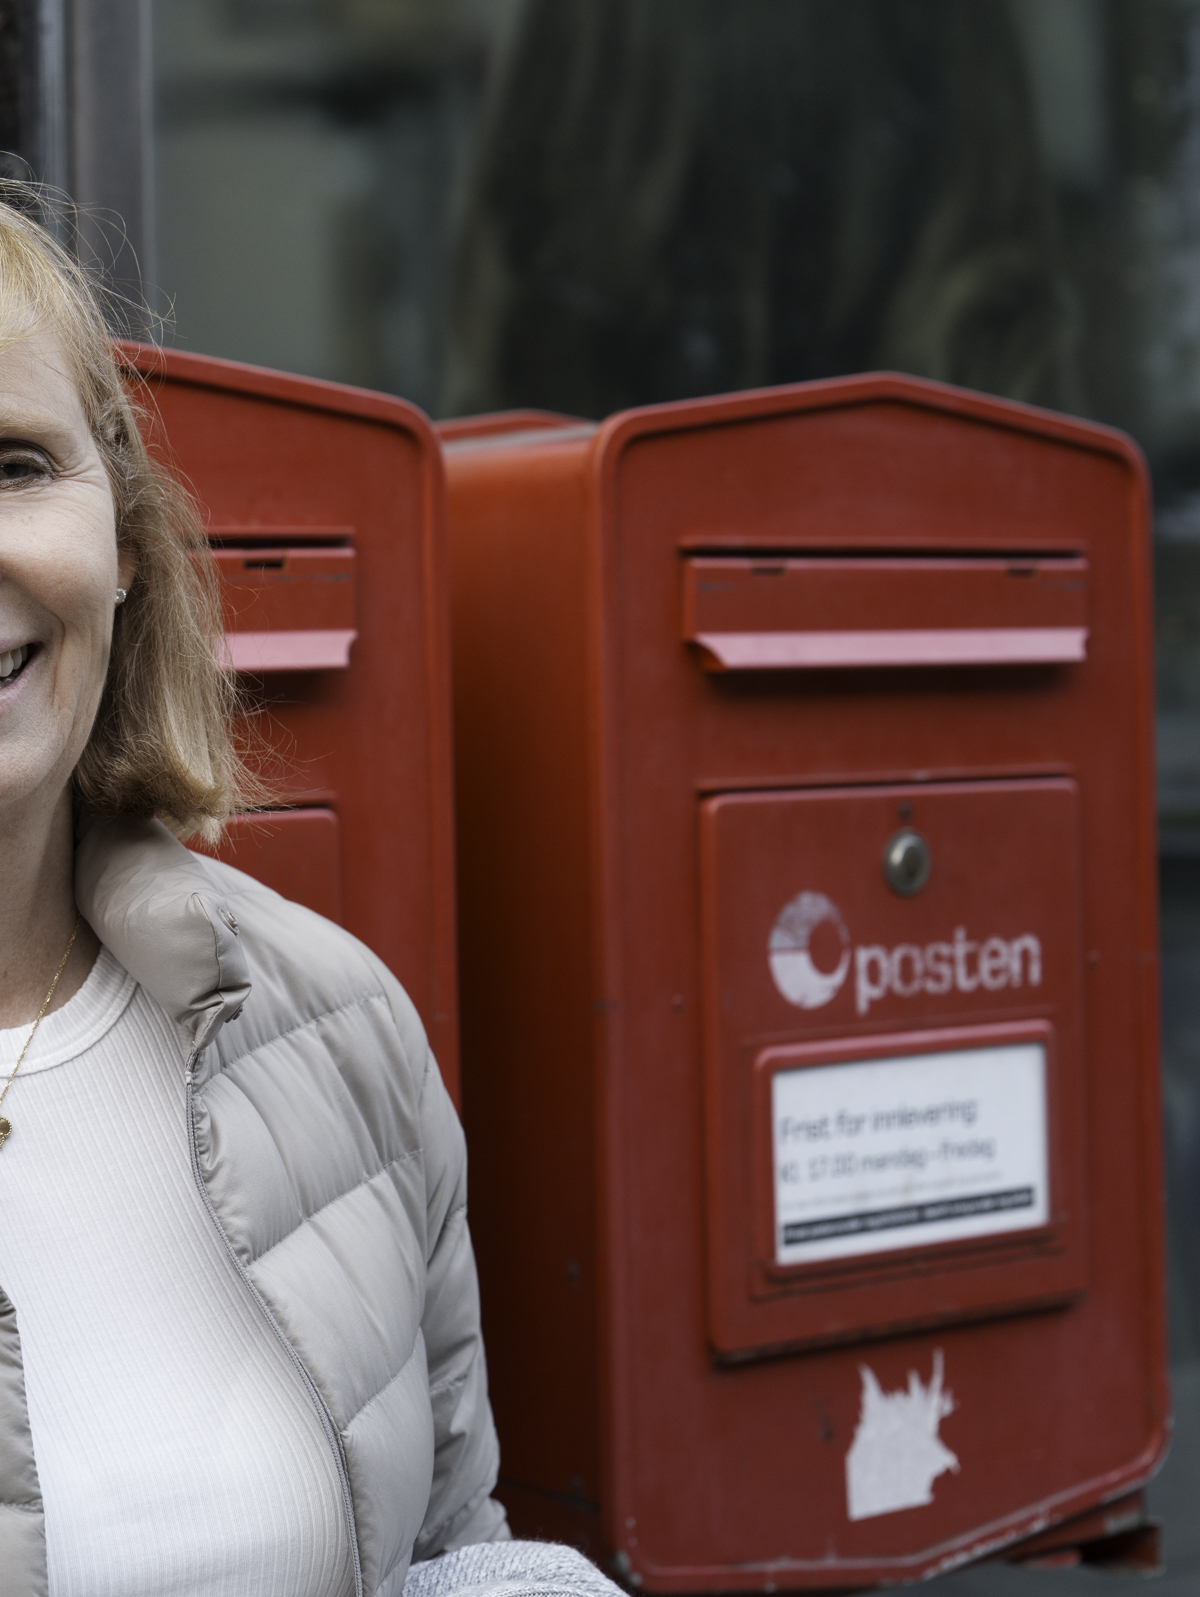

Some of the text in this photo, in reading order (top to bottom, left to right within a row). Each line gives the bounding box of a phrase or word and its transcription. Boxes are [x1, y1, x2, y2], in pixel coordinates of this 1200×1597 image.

[855, 926, 1042, 1015] posten
[779, 1116, 831, 1143] Frist
[834, 1109, 869, 1136] for
